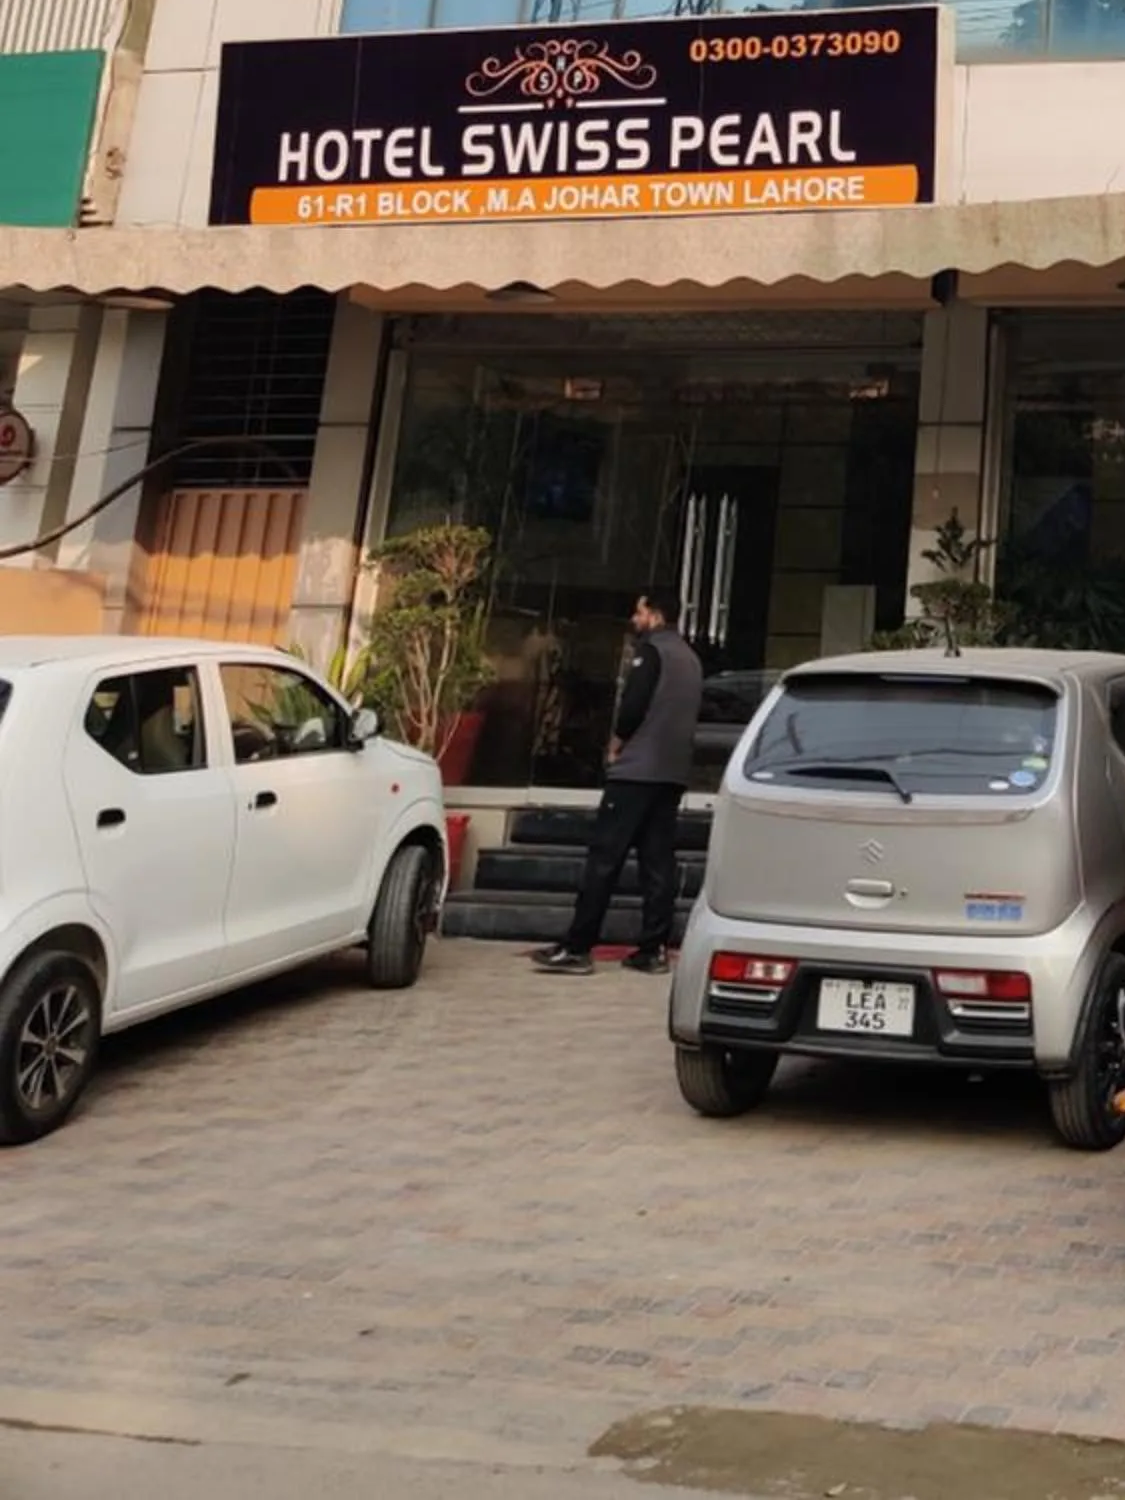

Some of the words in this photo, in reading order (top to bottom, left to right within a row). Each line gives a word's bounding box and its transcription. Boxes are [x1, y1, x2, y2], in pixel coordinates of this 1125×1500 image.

[689, 30, 901, 63] 0300-0373090
[278, 127, 445, 182] HOTEL
[461, 118, 651, 176] SWISS
[670, 110, 857, 169] PEARL
[297, 193, 368, 218] 61-R1
[377, 188, 473, 216] BLOCK
[543, 182, 641, 211] JOHAR
[648, 180, 735, 208] TOWN
[743, 175, 866, 204] LAHORE
[846, 991, 886, 1011] LEA
[845, 1010, 886, 1030] 345
